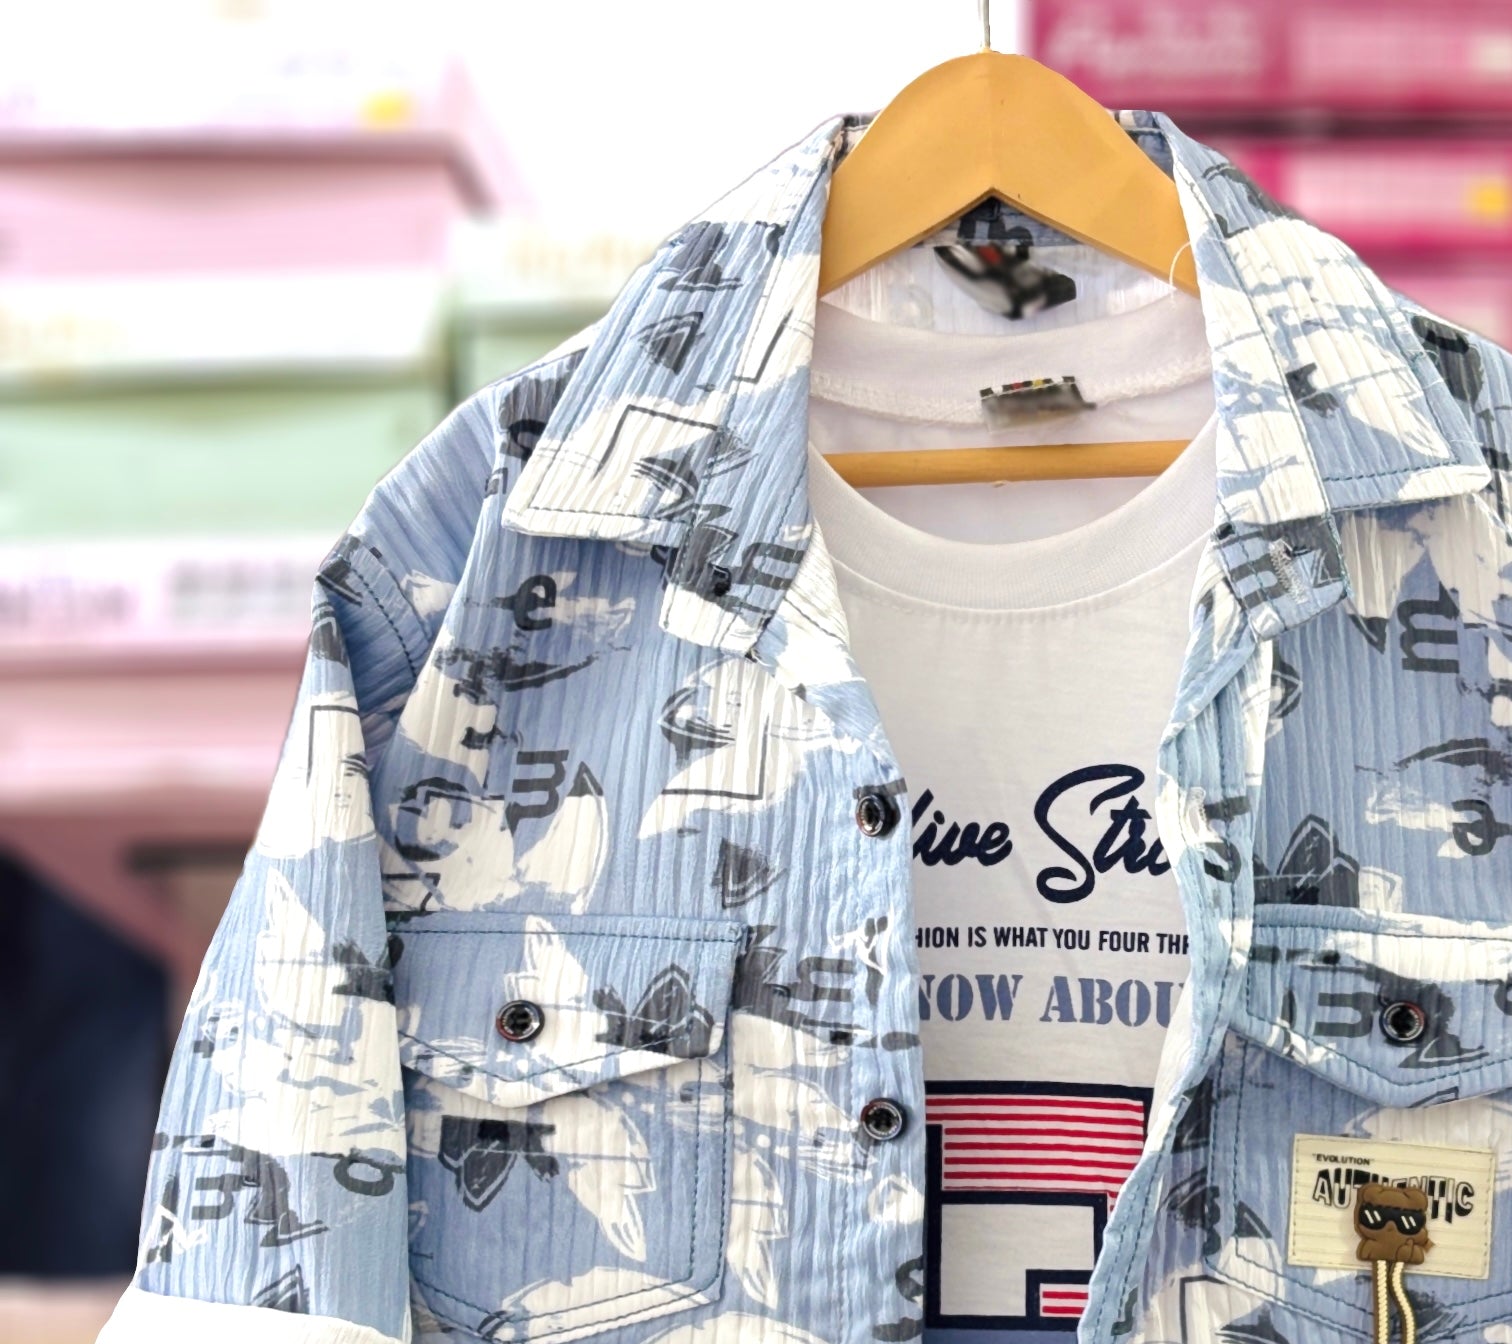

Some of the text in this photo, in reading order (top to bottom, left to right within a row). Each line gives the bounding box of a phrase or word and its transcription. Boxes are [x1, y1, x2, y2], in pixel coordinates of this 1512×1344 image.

[967, 926, 987, 948] IS
[993, 927, 1048, 949] WHAT
[1053, 928, 1090, 951] YOU
[1098, 930, 1150, 953] FOUR
[1312, 1167, 1475, 1224] AUTTIC
